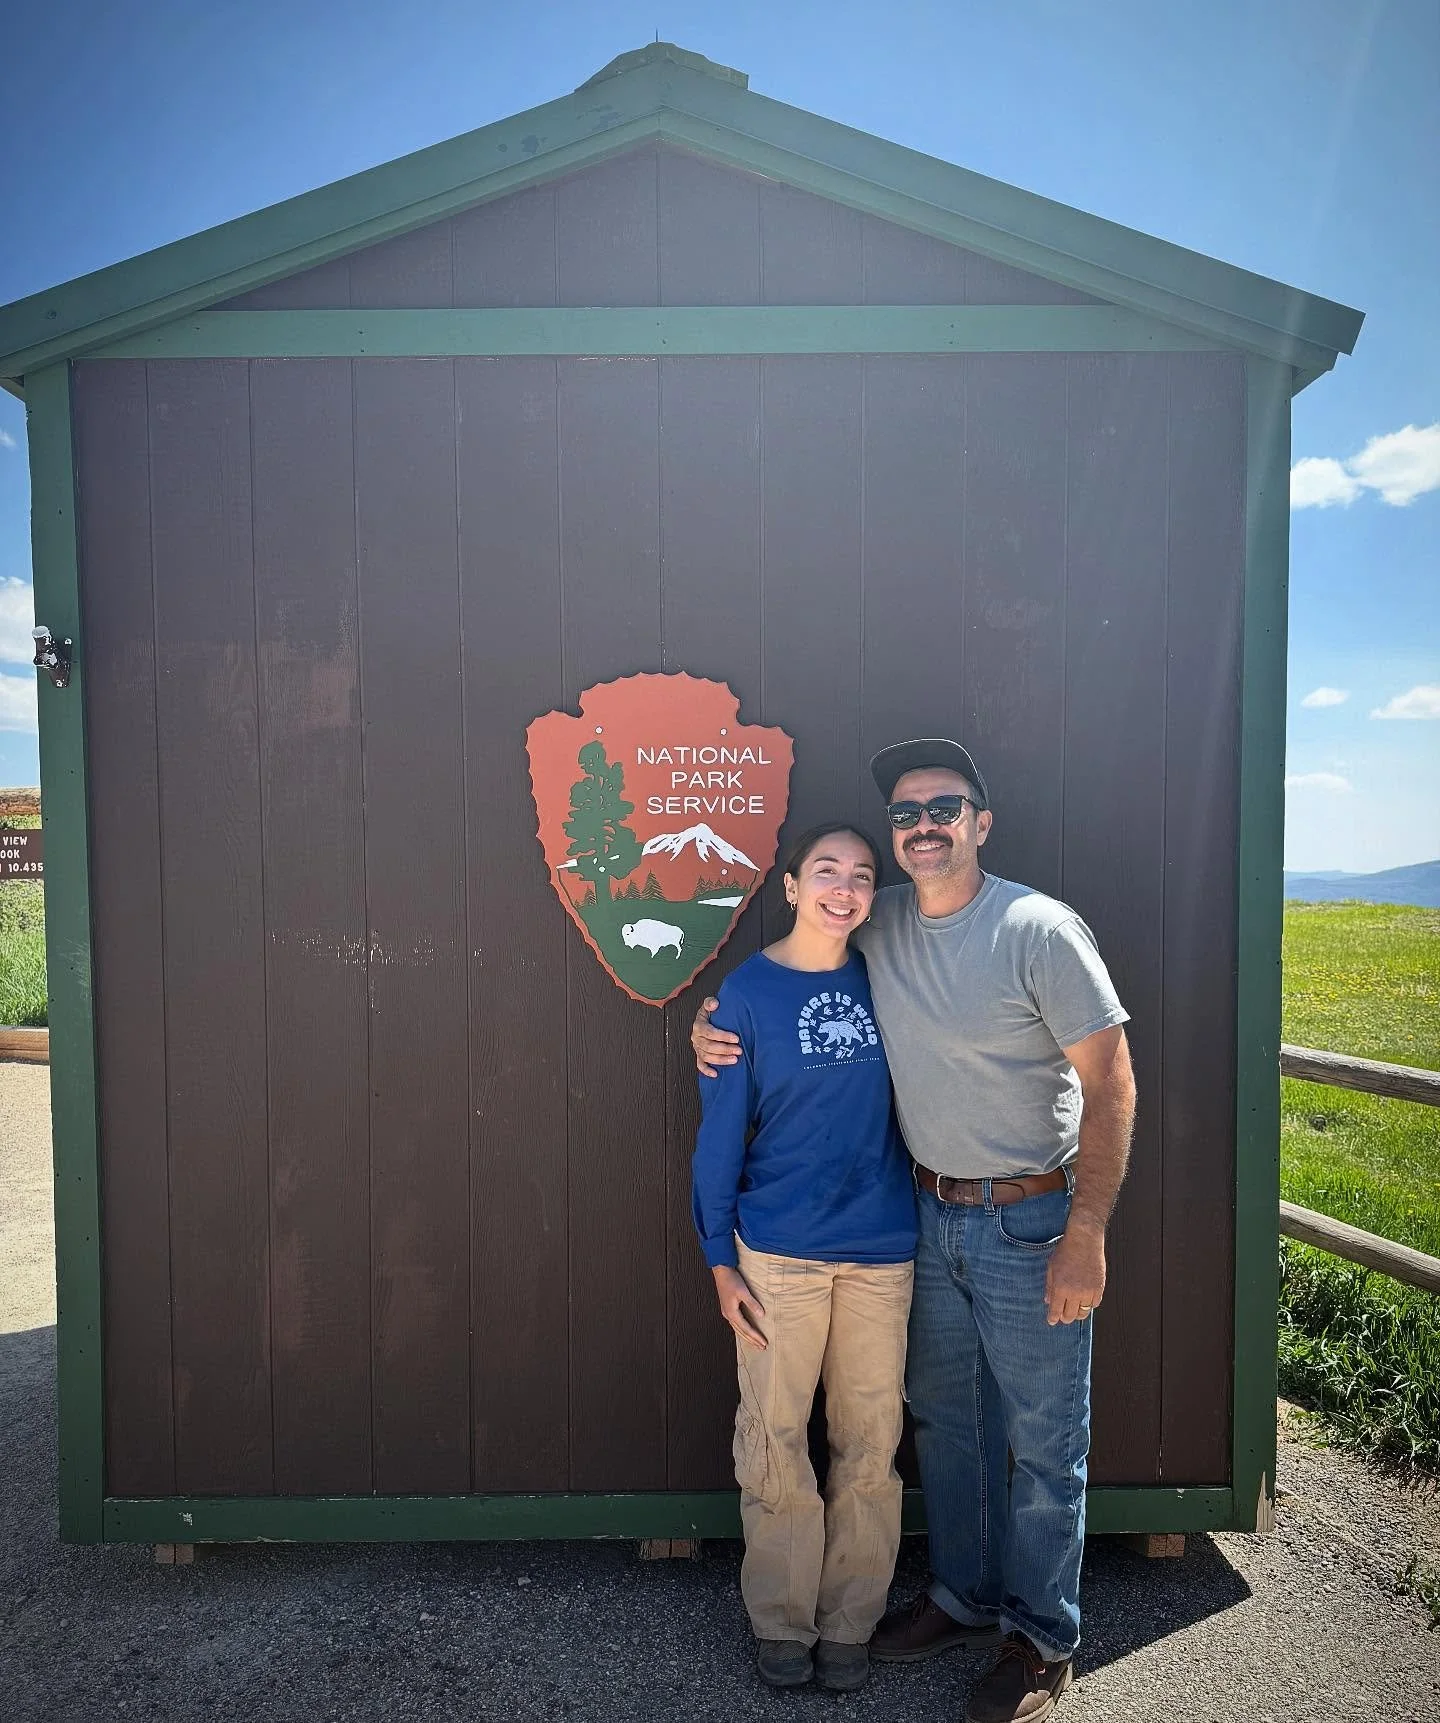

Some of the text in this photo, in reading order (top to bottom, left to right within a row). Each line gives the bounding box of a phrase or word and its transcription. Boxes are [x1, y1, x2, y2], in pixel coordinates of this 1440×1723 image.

[637, 746, 772, 765] NATIONAL
[671, 770, 743, 789] PARK
[646, 795, 765, 815] SERVICE
[2, 836, 28, 846] VIEW
[797, 991, 878, 1055] NATURE IS WILD
